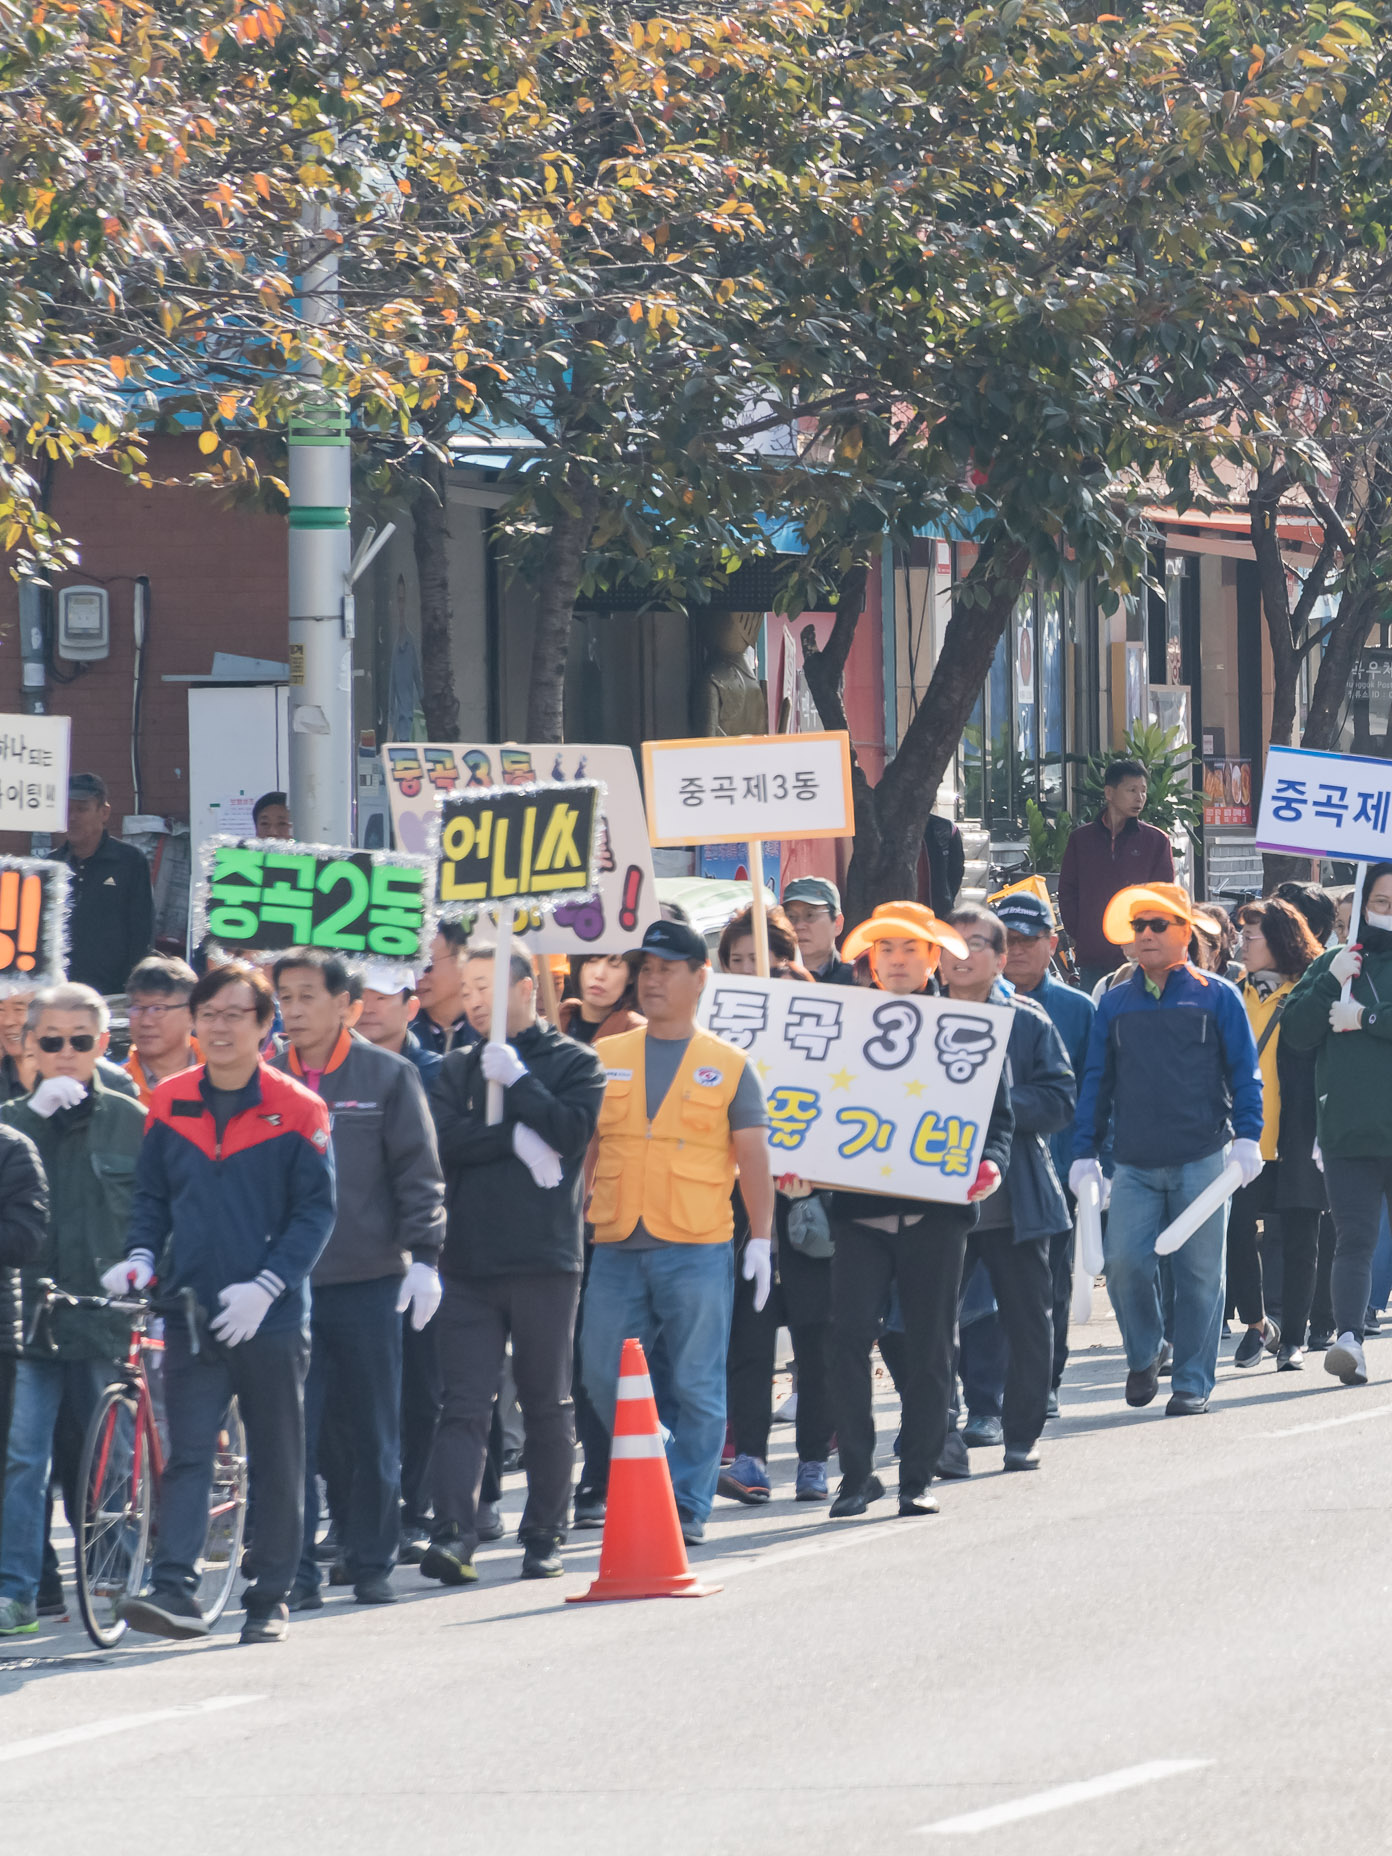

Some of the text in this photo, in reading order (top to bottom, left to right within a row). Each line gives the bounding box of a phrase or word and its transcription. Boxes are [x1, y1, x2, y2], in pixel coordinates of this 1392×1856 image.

[679, 771, 820, 807] 중곡제3동
[209, 847, 425, 956] 중곡2동
[440, 803, 588, 902] 언니쓰
